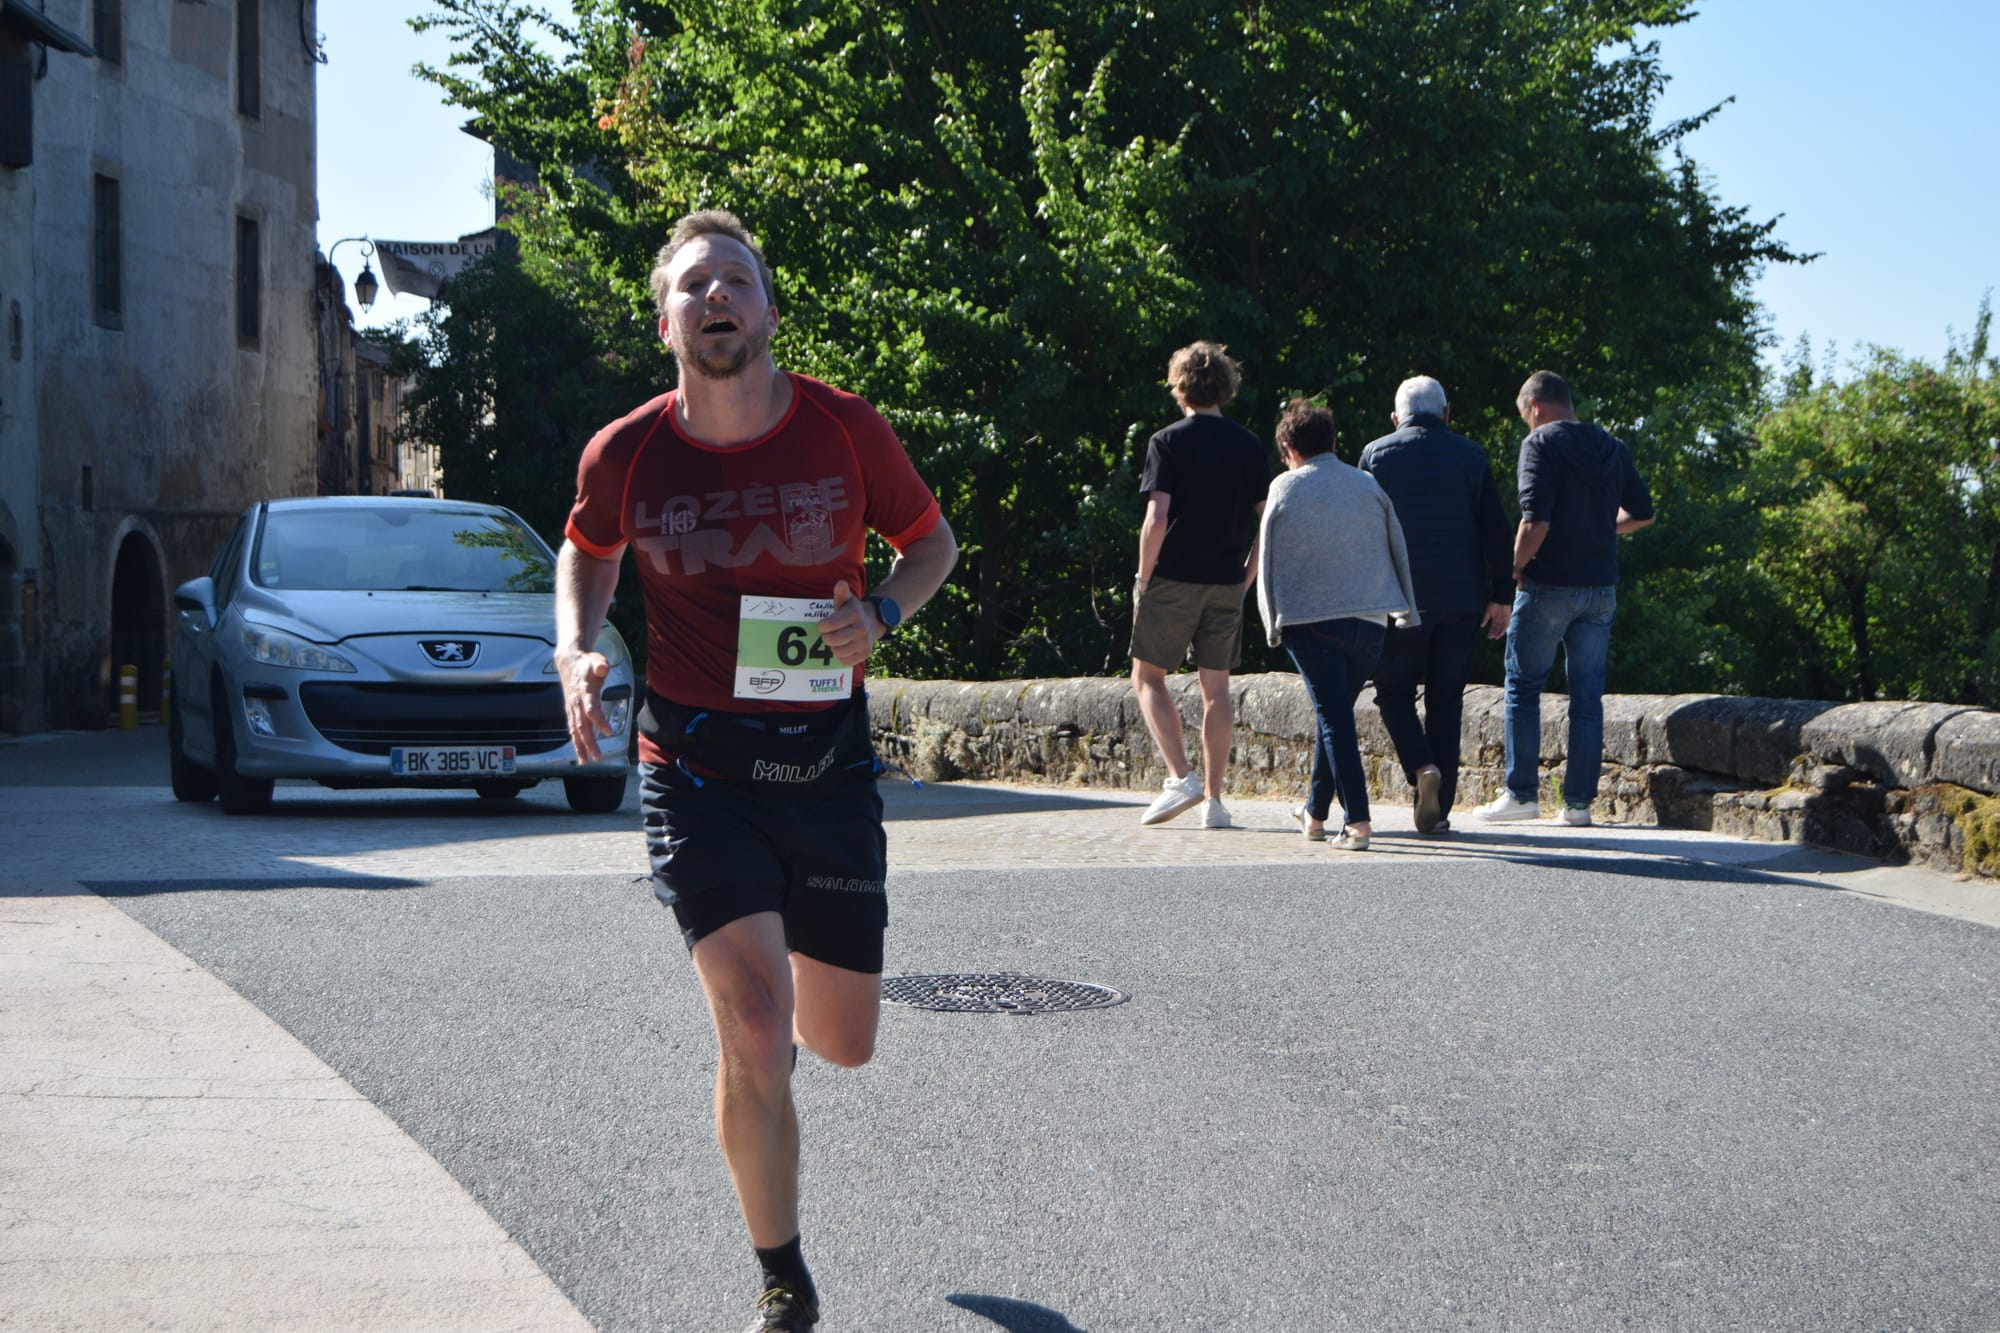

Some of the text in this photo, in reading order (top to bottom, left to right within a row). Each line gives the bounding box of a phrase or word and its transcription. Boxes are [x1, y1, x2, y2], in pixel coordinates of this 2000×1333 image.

[379, 243, 444, 255] MAISON
[449, 243, 469, 255] DE
[636, 476, 849, 528] LOZÈRE
[777, 626, 834, 666] 64
[749, 677, 780, 687] BFP
[779, 725, 809, 734] MILLET
[408, 751, 498, 771] BK-385-VC
[806, 875, 883, 894] SALOM
